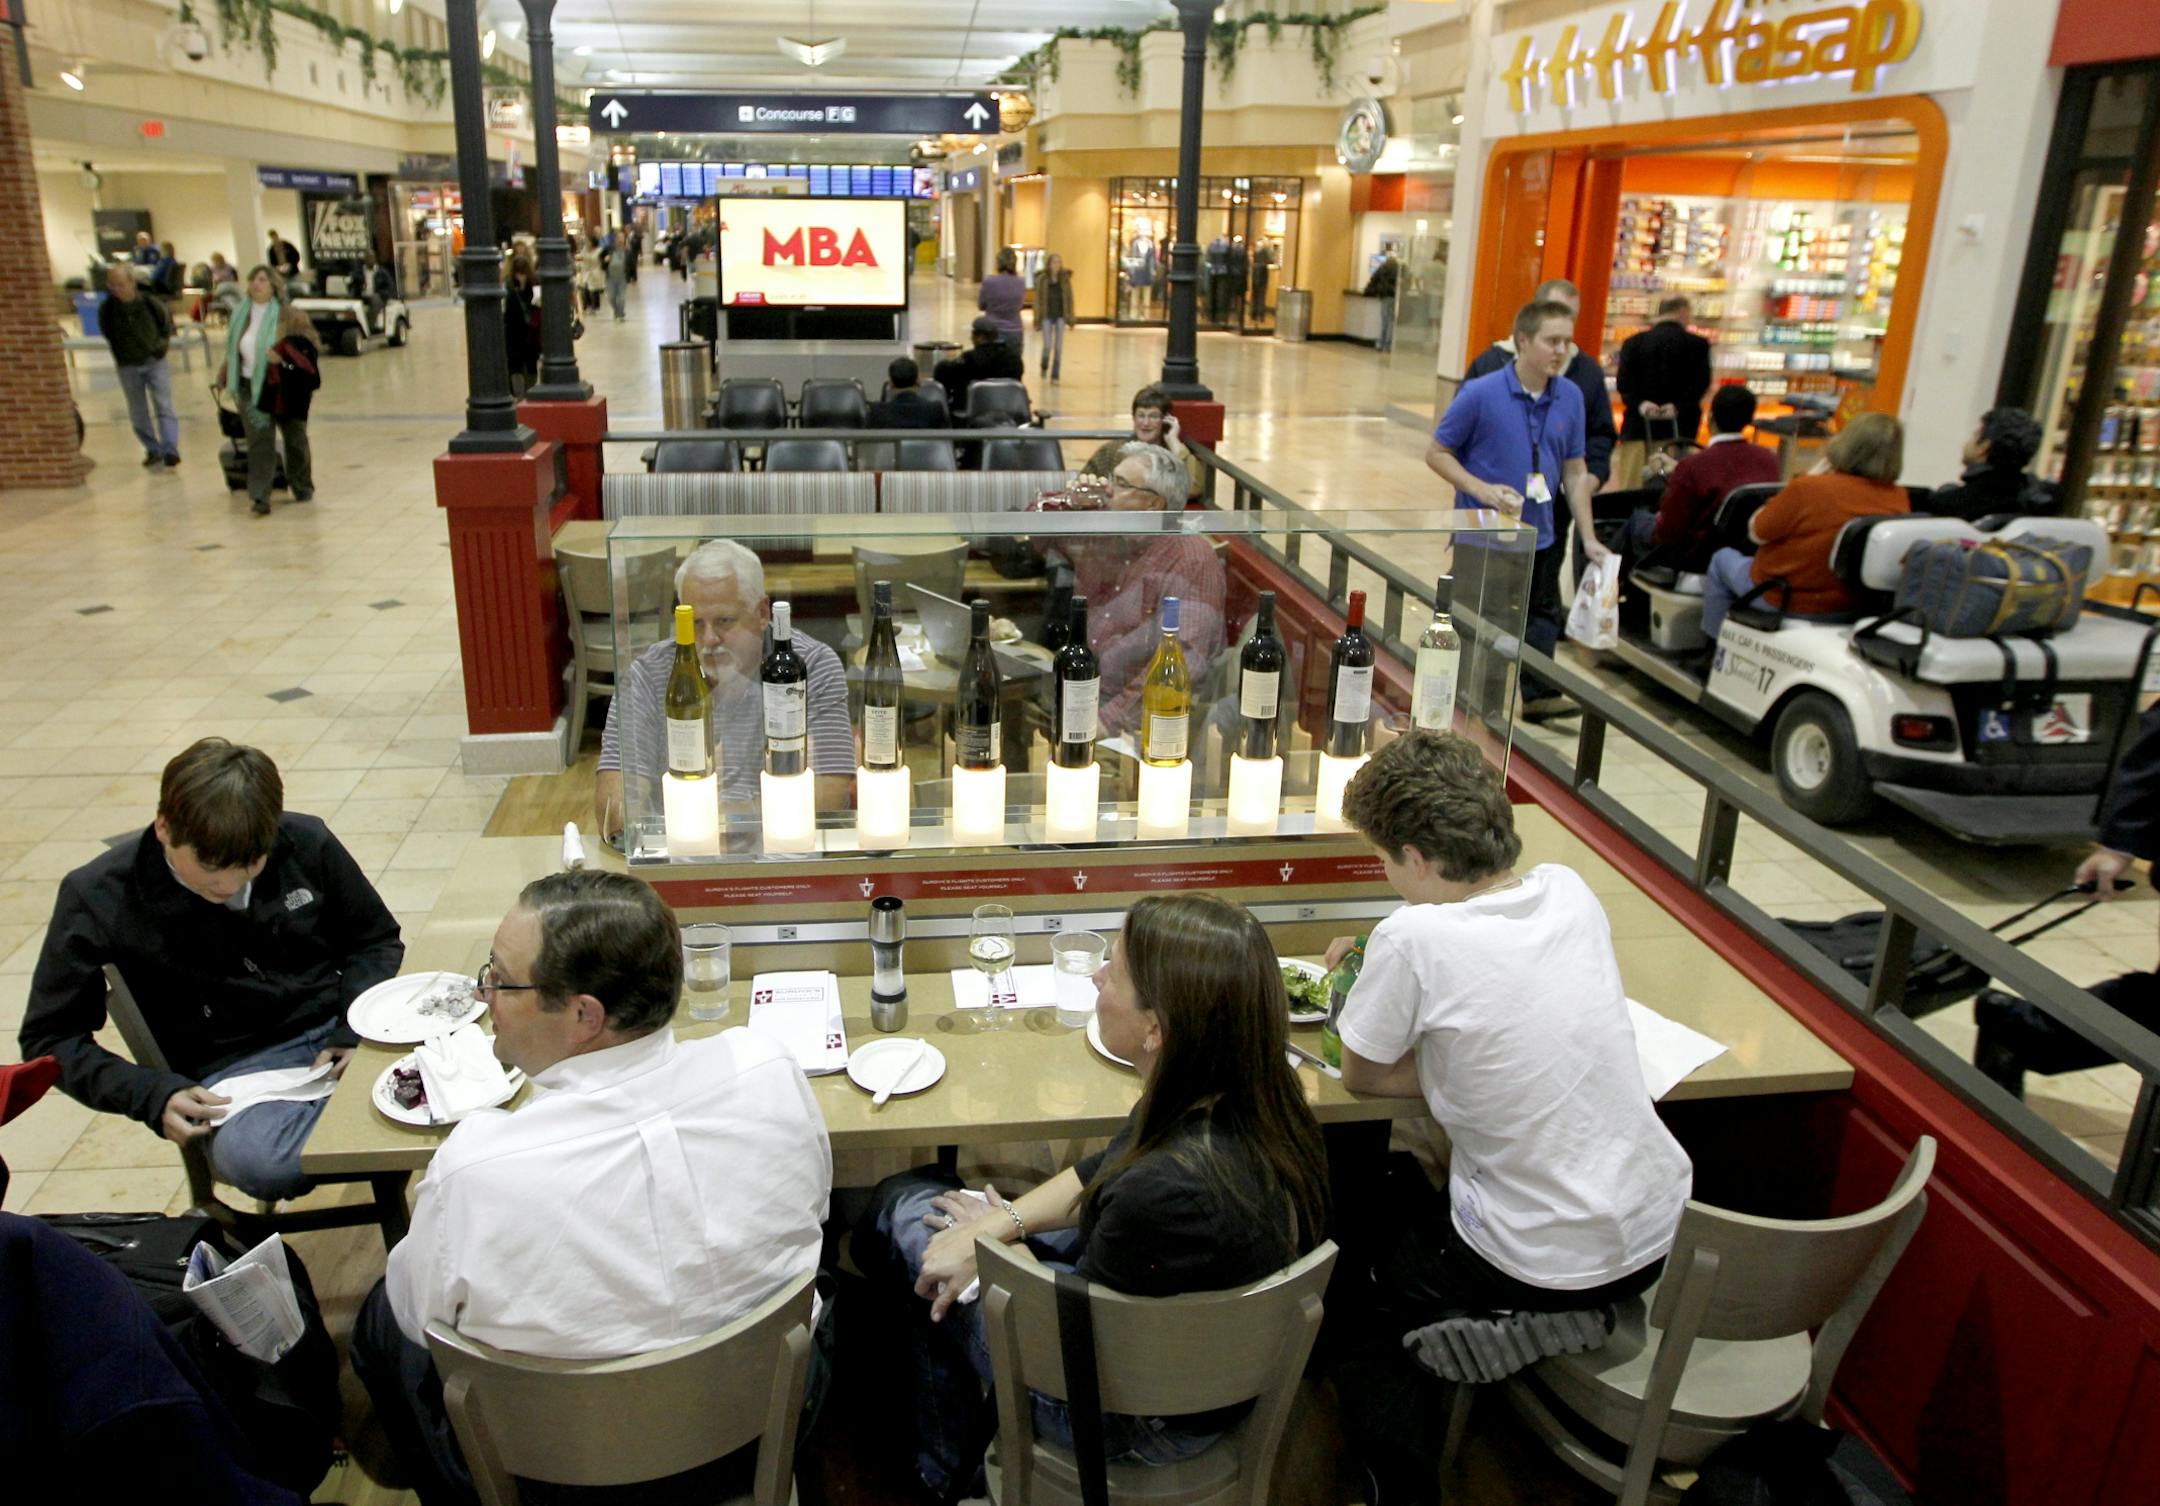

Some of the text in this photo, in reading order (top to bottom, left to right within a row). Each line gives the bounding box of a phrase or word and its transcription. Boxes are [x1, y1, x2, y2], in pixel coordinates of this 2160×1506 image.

[1734, 0, 1917, 92] asap
[756, 106, 855, 121] Concourse F G
[320, 232, 368, 249] NEWS
[762, 226, 879, 267] MBA
[1763, 645, 1815, 673] PASSENGERS
[1757, 664, 1776, 695] 17
